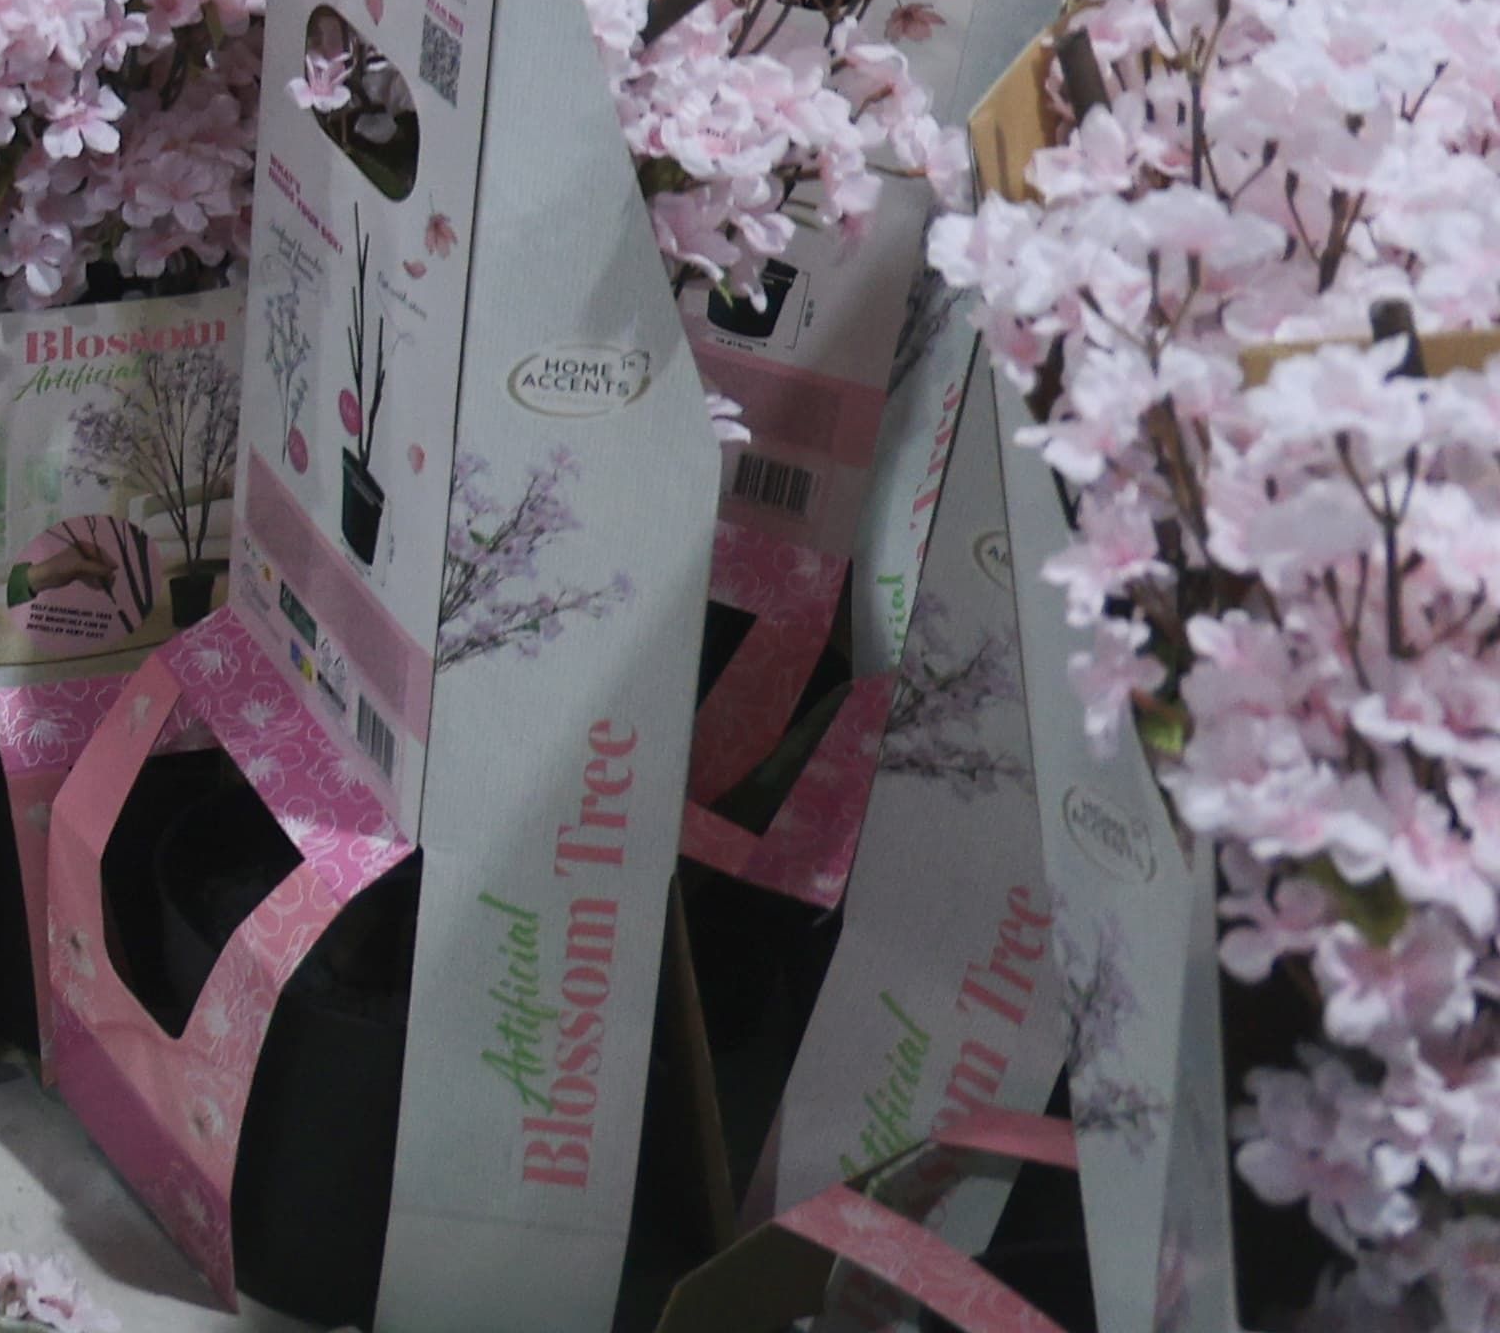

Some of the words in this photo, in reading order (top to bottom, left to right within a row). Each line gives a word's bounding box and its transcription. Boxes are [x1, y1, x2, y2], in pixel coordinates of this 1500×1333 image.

[12, 354, 146, 402] Artificial
[25, 320, 227, 365] Blossom
[522, 372, 630, 398] ACCENTS
[544, 358, 611, 378] HOME
[553, 718, 639, 878] Tree
[477, 889, 560, 1116] Artificial
[954, 885, 1054, 1026] Tree
[521, 897, 620, 1190] Blossom
